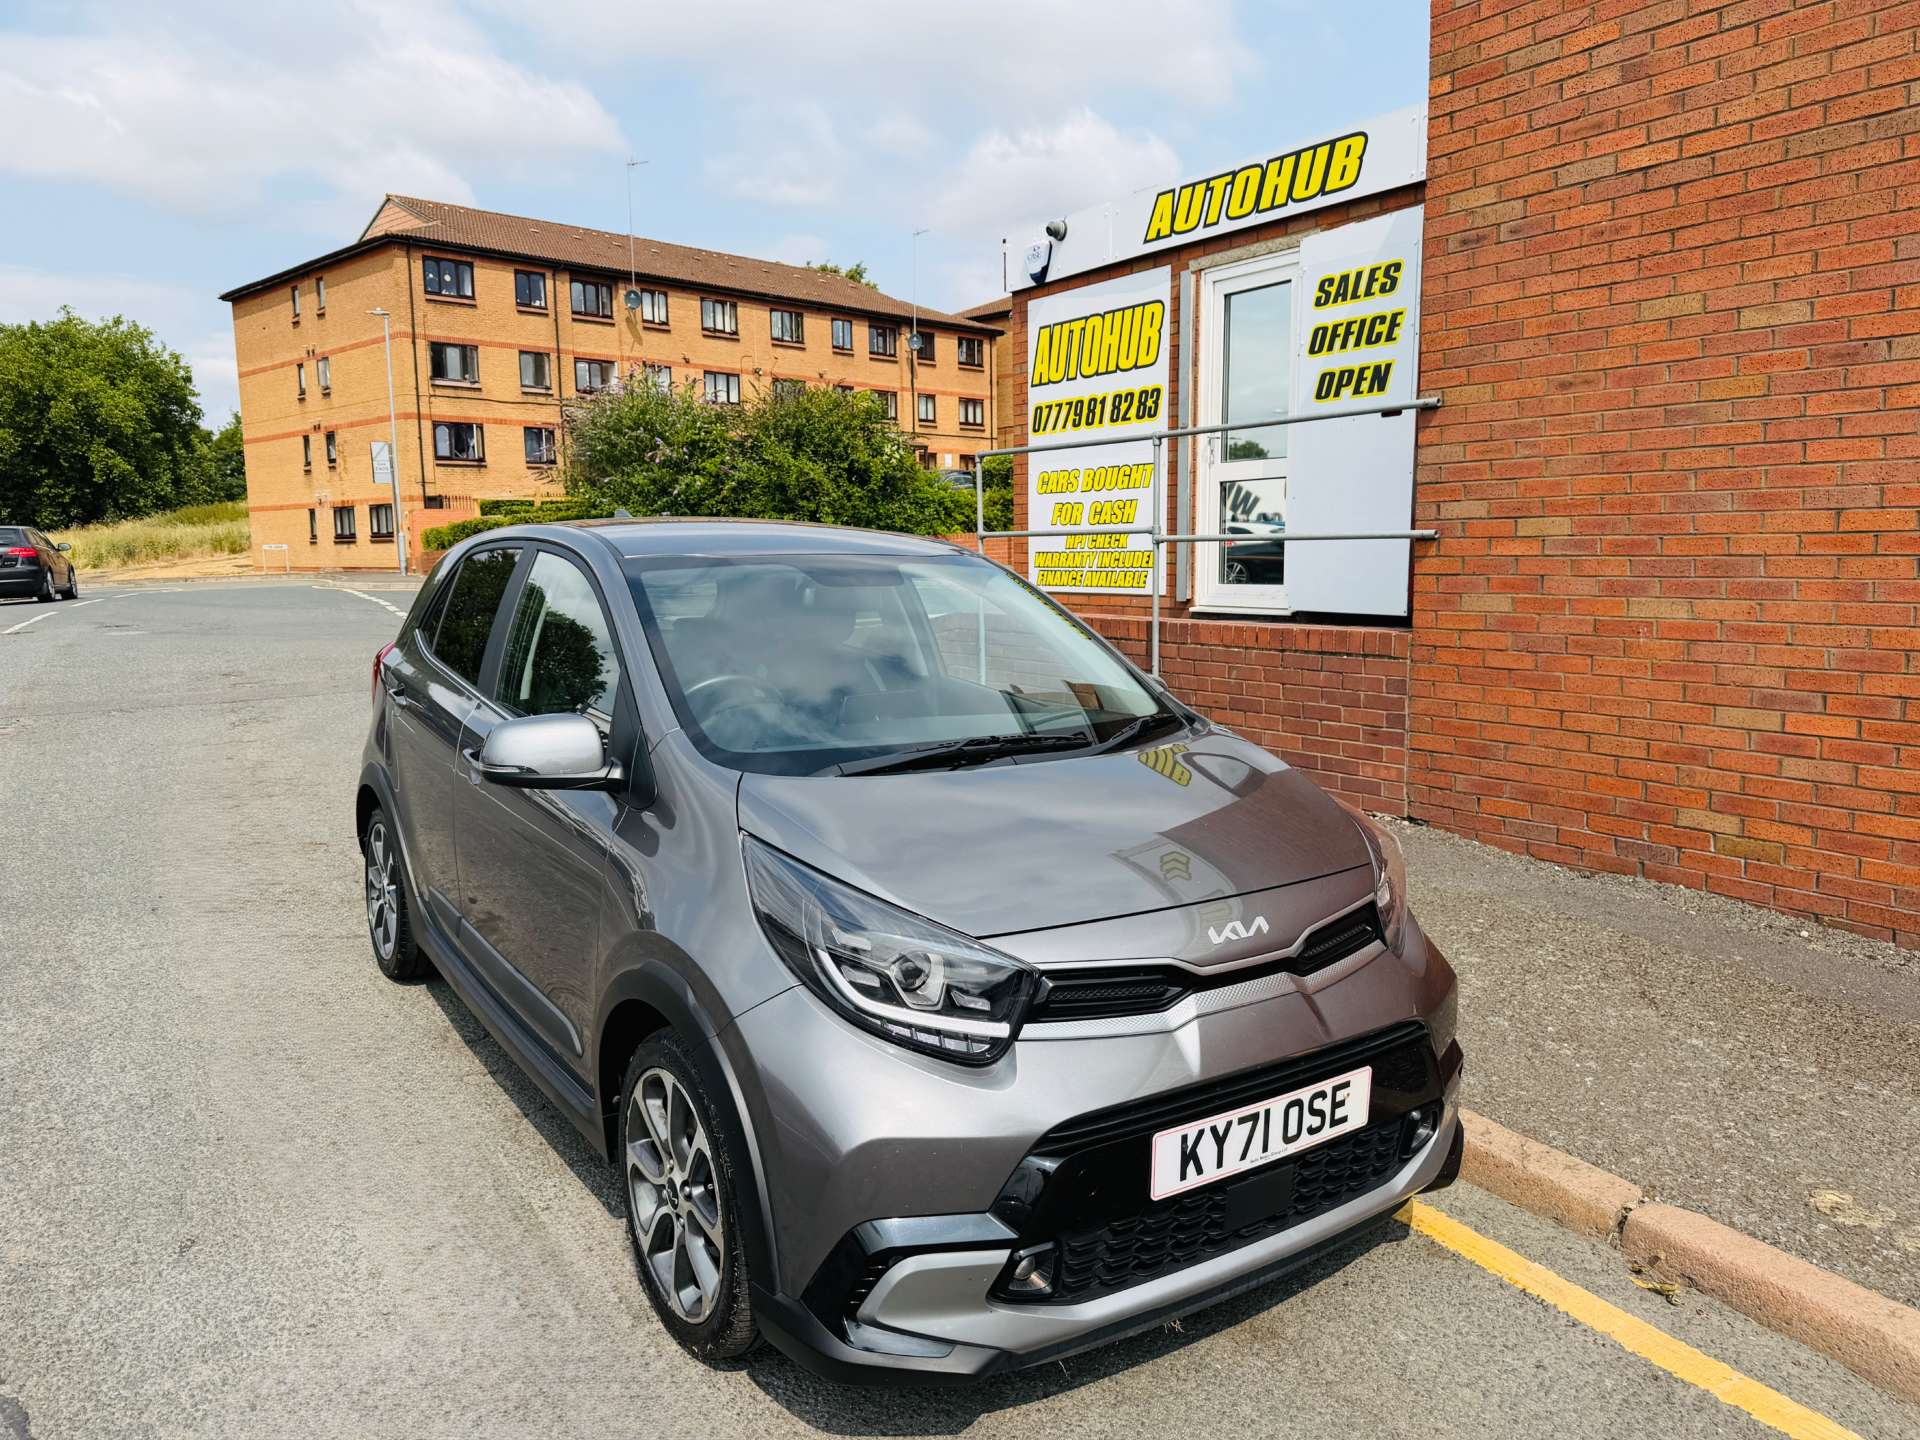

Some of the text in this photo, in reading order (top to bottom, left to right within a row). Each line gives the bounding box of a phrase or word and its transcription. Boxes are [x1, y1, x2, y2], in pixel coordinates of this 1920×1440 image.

[1143, 131, 1369, 244] AUTOHUB
[1313, 259, 1403, 309] SALES
[1031, 300, 1165, 387] AUTOHUB
[1307, 309, 1406, 357] OFFICE
[1313, 361, 1394, 401] OPEN
[1037, 463, 1154, 495] CARS BOUGHT
[1051, 499, 1139, 526] FOR CASH
[1065, 533, 1129, 549] HPI CHECK
[1034, 551, 1098, 569] WARRANTY
[1036, 570, 1149, 588] FINANCE AVAILABLE
[1208, 915, 1269, 945] KIA
[1178, 1080, 1352, 1184] KY71 OSE
